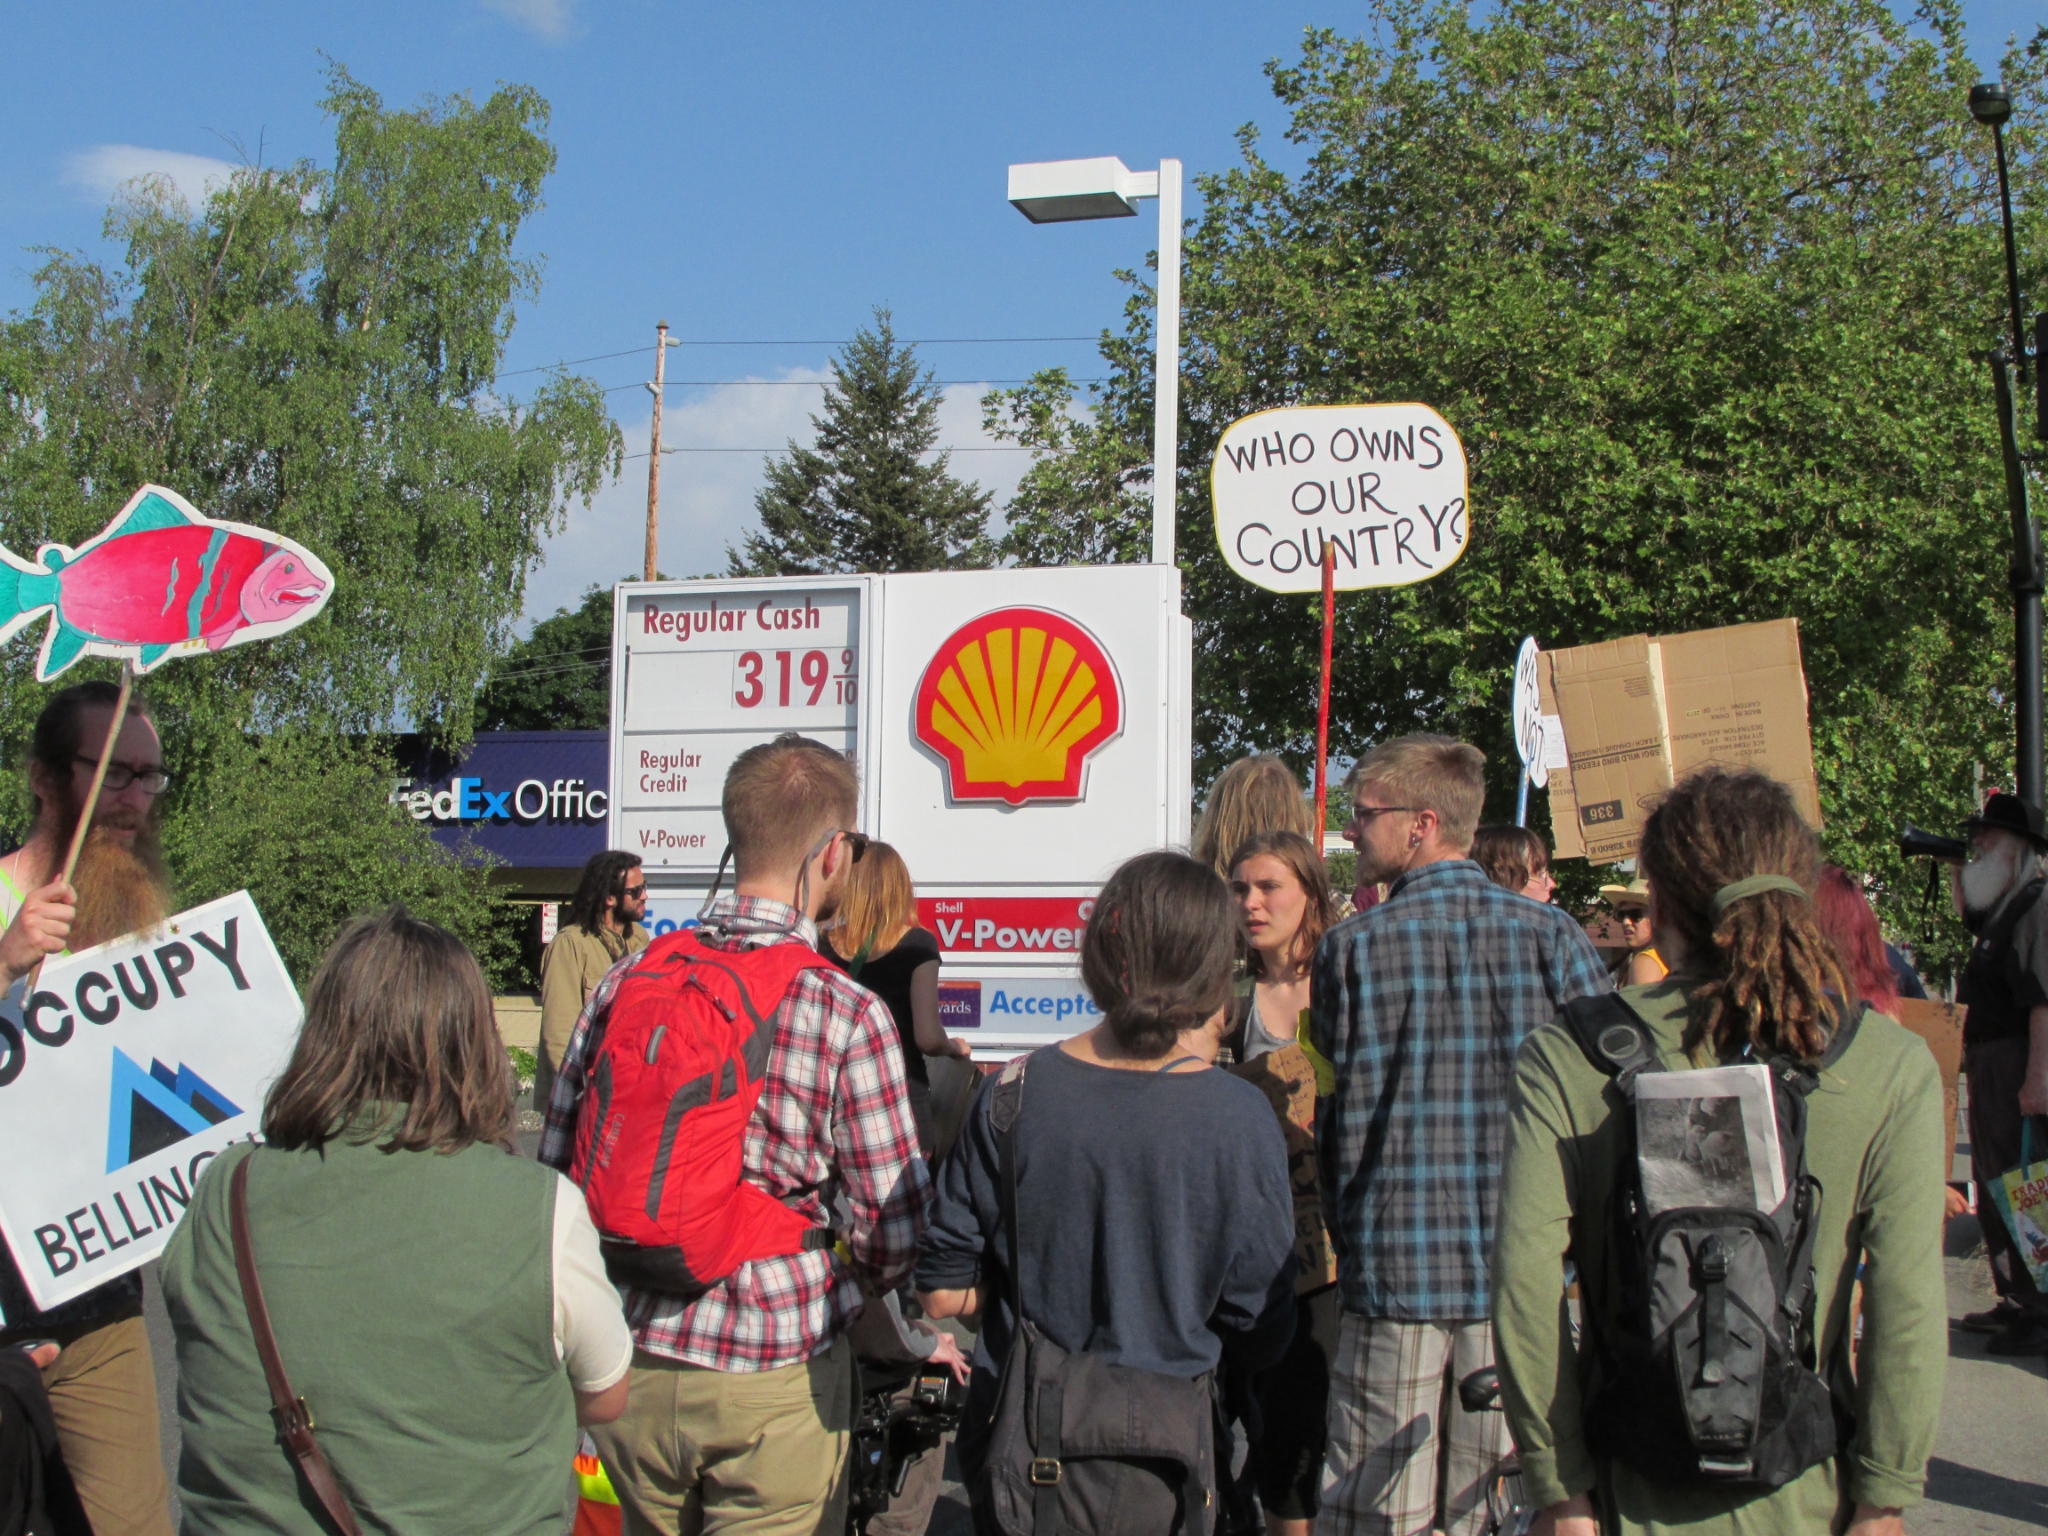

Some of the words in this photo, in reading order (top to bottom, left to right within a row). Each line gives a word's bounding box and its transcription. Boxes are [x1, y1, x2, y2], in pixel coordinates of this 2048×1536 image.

[1224, 431, 1315, 473] WHO
[1330, 425, 1443, 469] OWNS
[1291, 472, 1398, 515] OUR
[1237, 497, 1465, 573] COUNTRY?
[644, 600, 747, 642] Regular
[756, 597, 820, 631] Cash
[735, 650, 829, 708] 319
[841, 648, 854, 674] 9
[835, 680, 858, 705] 10
[1744, 708, 1761, 716] MADE
[1635, 738, 1653, 746] EACH
[640, 748, 702, 773] Regular
[1602, 756, 1620, 766] BIRD
[1621, 753, 1640, 762] WILD
[640, 773, 687, 793] Credit
[388, 777, 511, 820] FedEx
[1589, 805, 1614, 820] 336
[639, 829, 706, 848] V-Power
[935, 902, 963, 913] Shell
[935, 918, 1084, 949] V-Power
